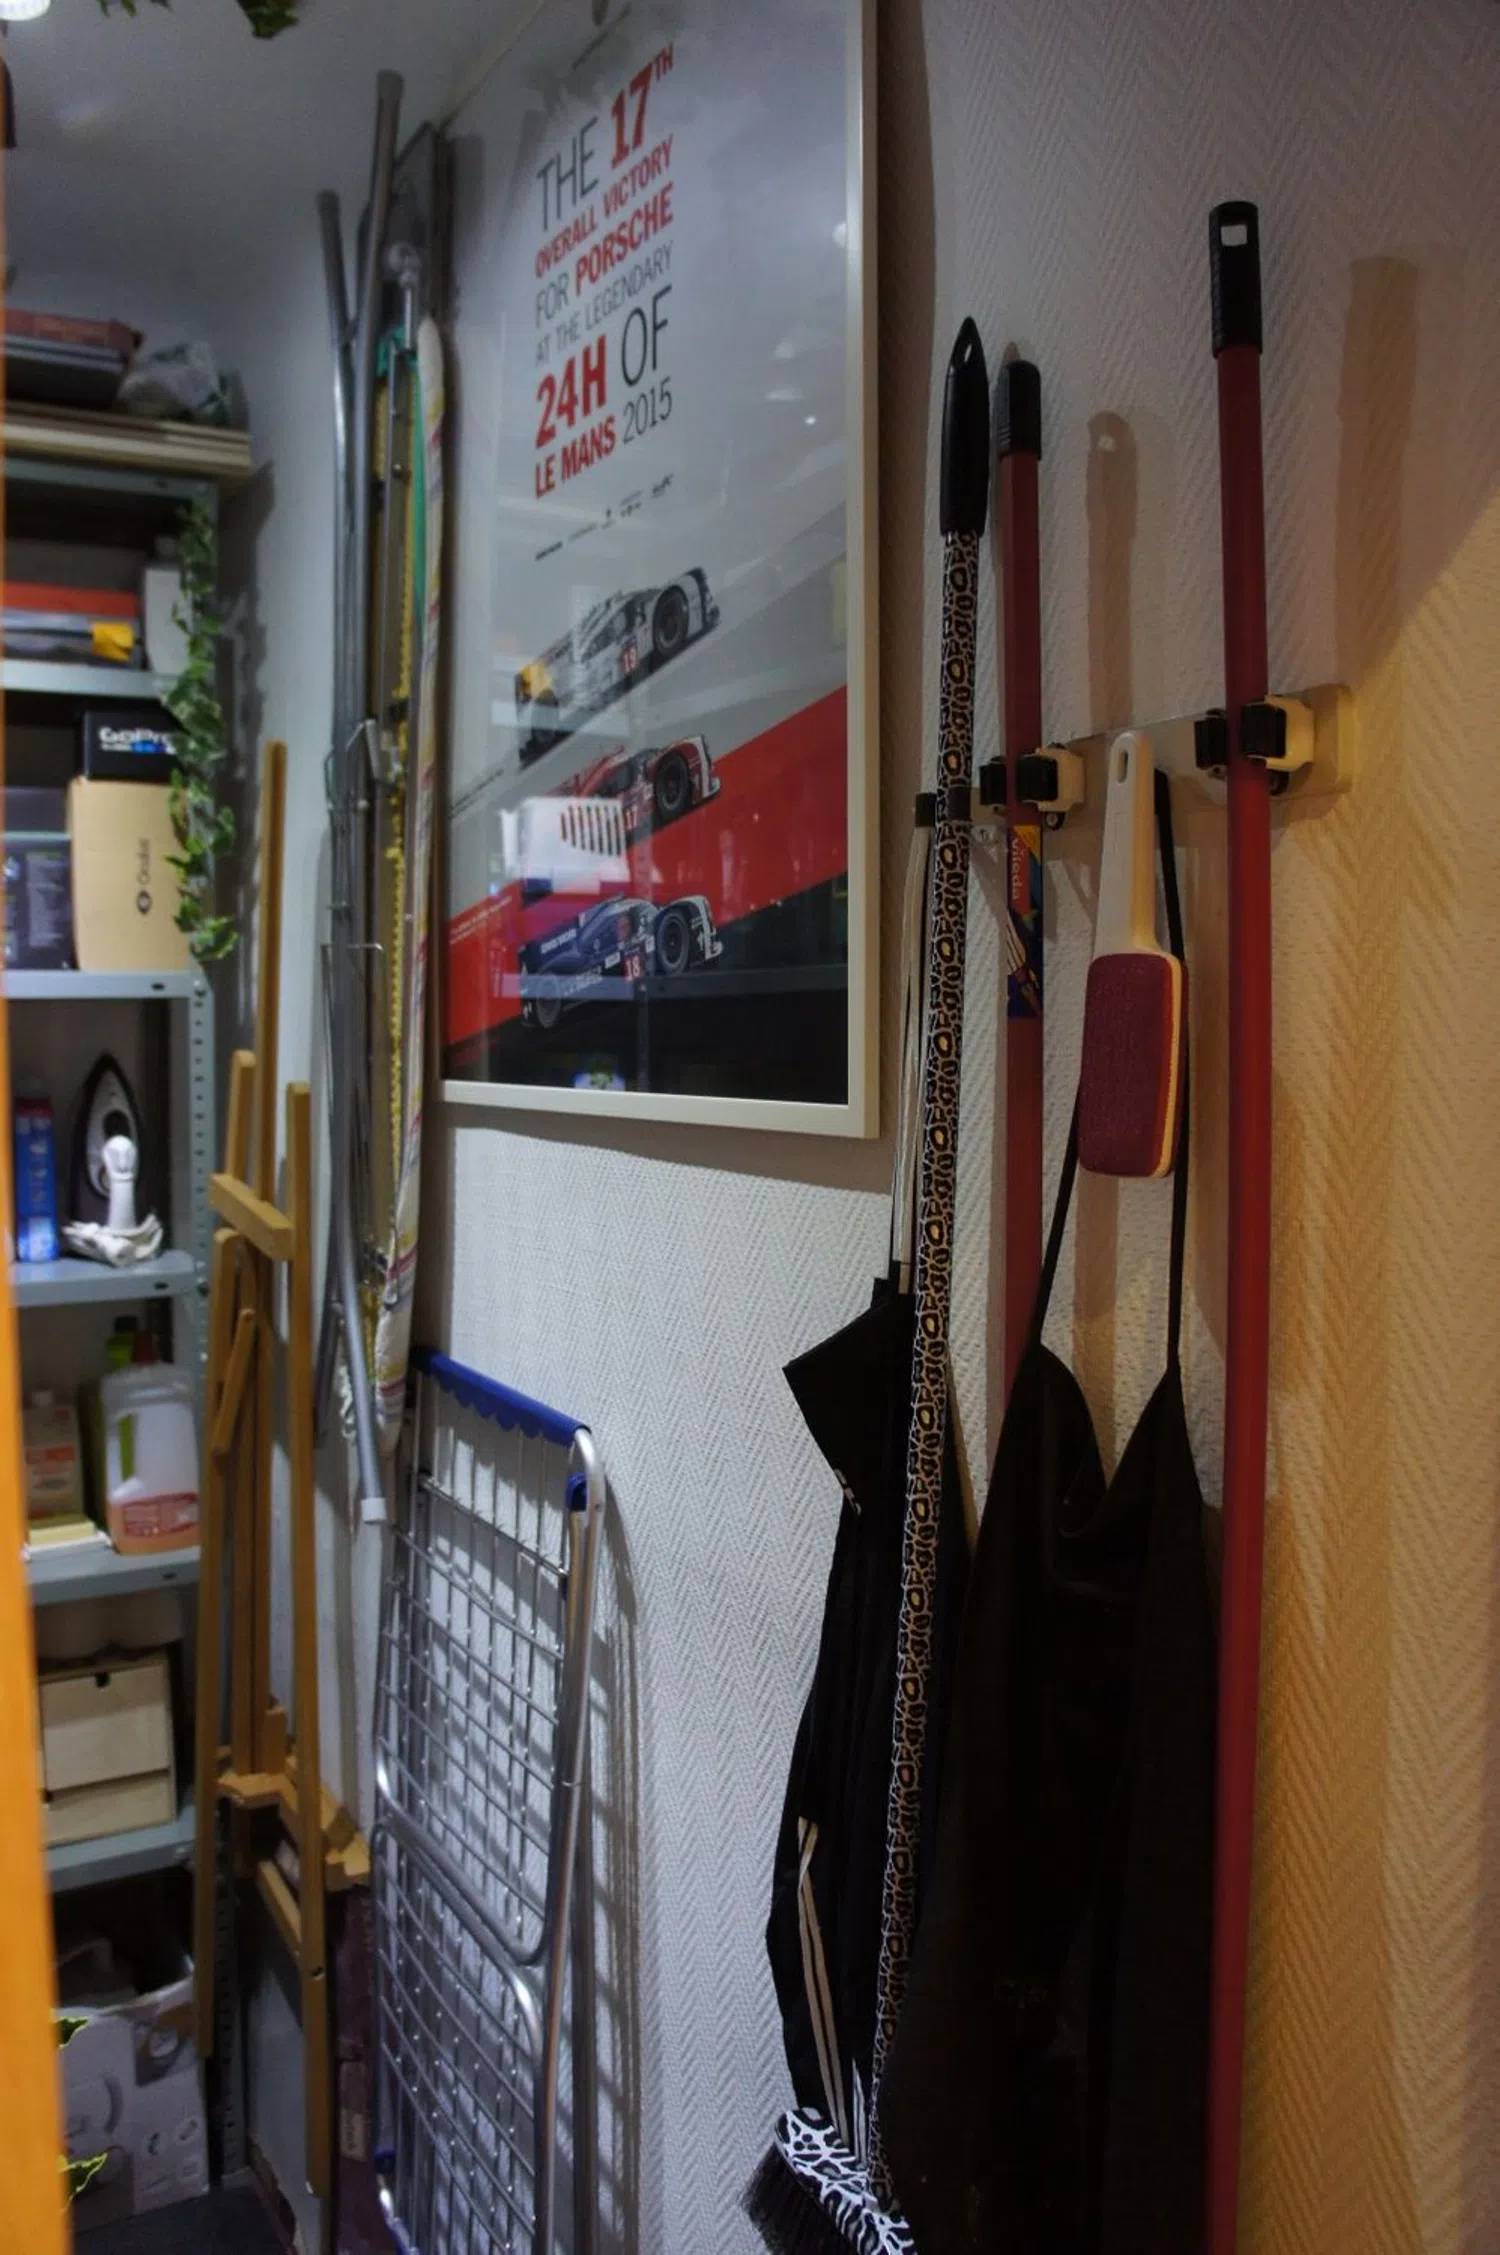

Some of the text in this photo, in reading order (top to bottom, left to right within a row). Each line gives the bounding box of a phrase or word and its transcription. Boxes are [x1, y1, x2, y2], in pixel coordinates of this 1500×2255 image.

[535, 133, 674, 279] OVERALL VICTORY
[536, 41, 674, 231] THE 17TH
[536, 181, 674, 329] FOR PORSCHE
[536, 240, 674, 366] AT THE LEGENDARY
[535, 375, 673, 500] LE MANS 2015
[536, 283, 673, 449] 24H OF
[625, 955, 640, 981] 18
